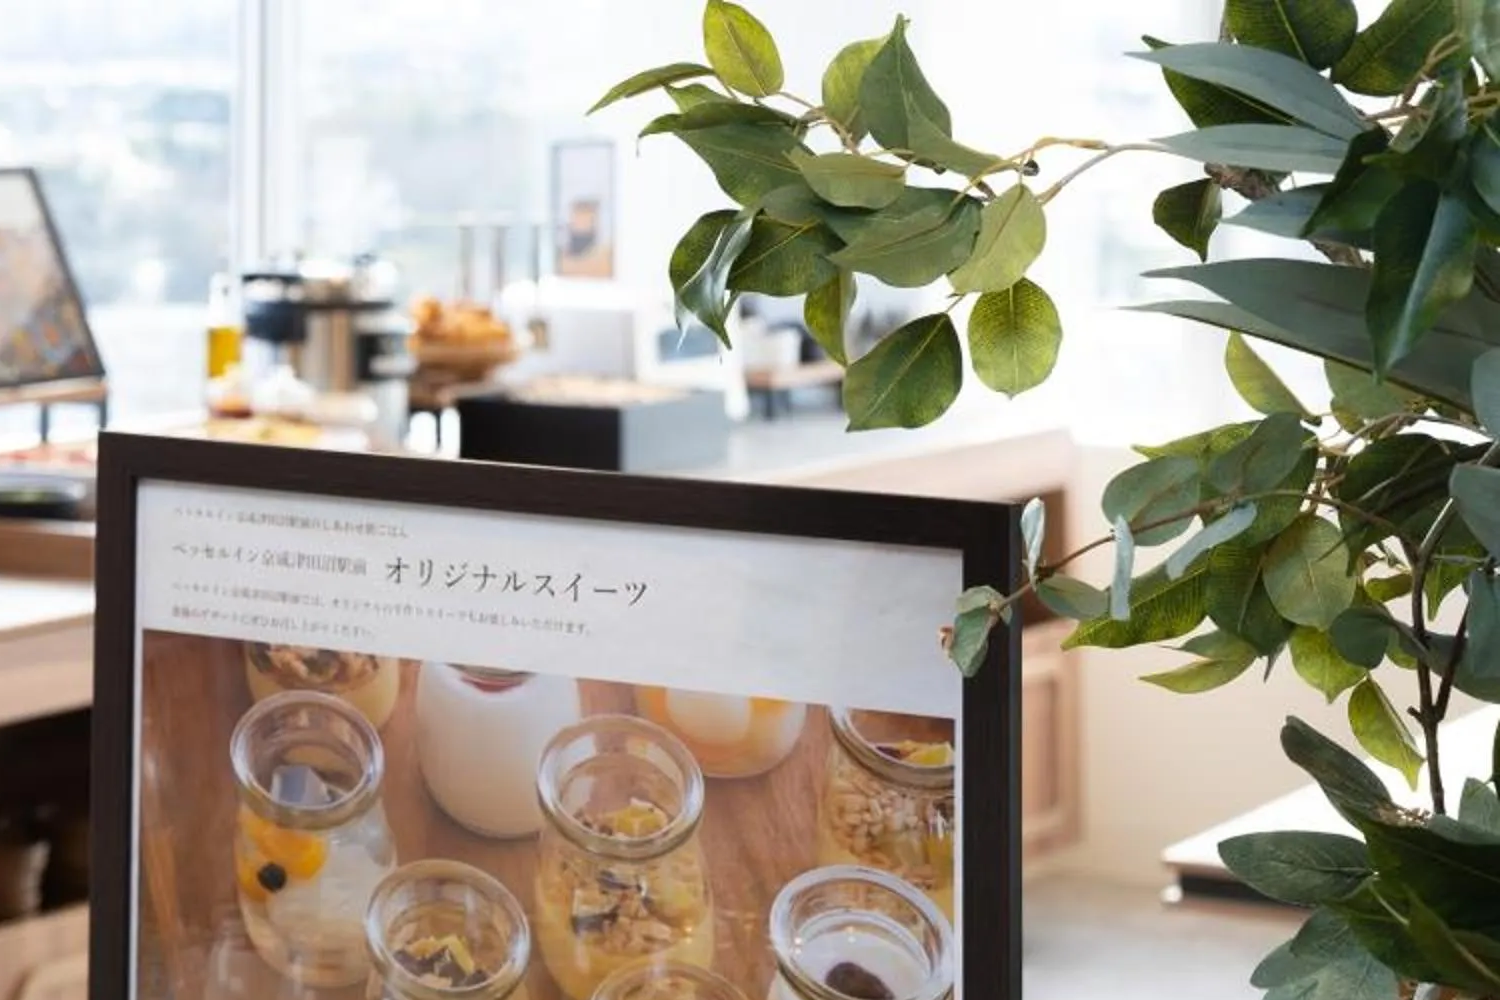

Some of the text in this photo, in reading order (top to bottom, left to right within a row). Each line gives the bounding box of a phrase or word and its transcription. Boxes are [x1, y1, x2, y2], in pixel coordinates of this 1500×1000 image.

[386, 557, 647, 606] オリジナルスイーツ
